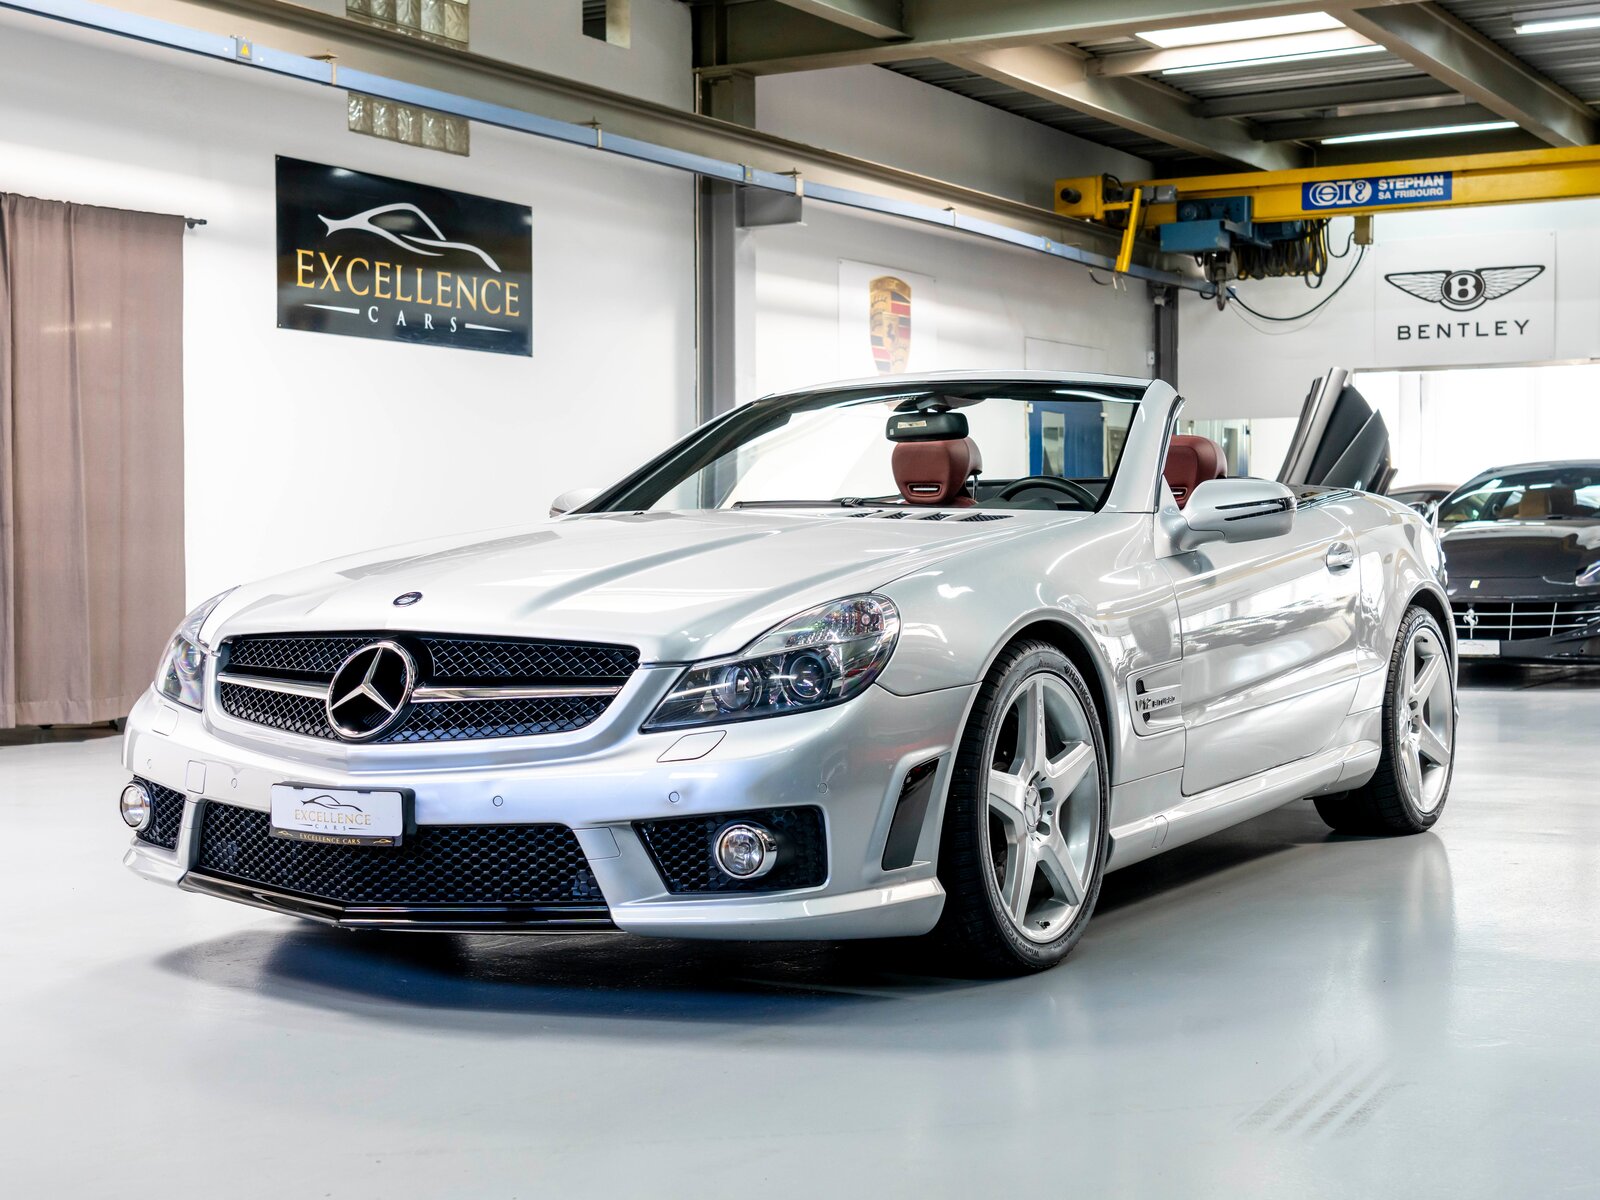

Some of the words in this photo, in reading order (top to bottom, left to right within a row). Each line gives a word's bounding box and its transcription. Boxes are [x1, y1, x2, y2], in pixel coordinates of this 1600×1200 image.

[1378, 175, 1444, 191] STEPHAN
[1378, 191, 1392, 200] SA
[1394, 187, 1444, 199] FRIBOURG
[296, 248, 520, 317] EXCELLENCE
[1449, 273, 1477, 302] B
[367, 305, 457, 332] CARS
[1397, 319, 1530, 341] BENTLEY
[294, 809, 372, 826] EXCELLENCE
[314, 823, 347, 832] CARS
[299, 833, 340, 845] EXCELLENCE
